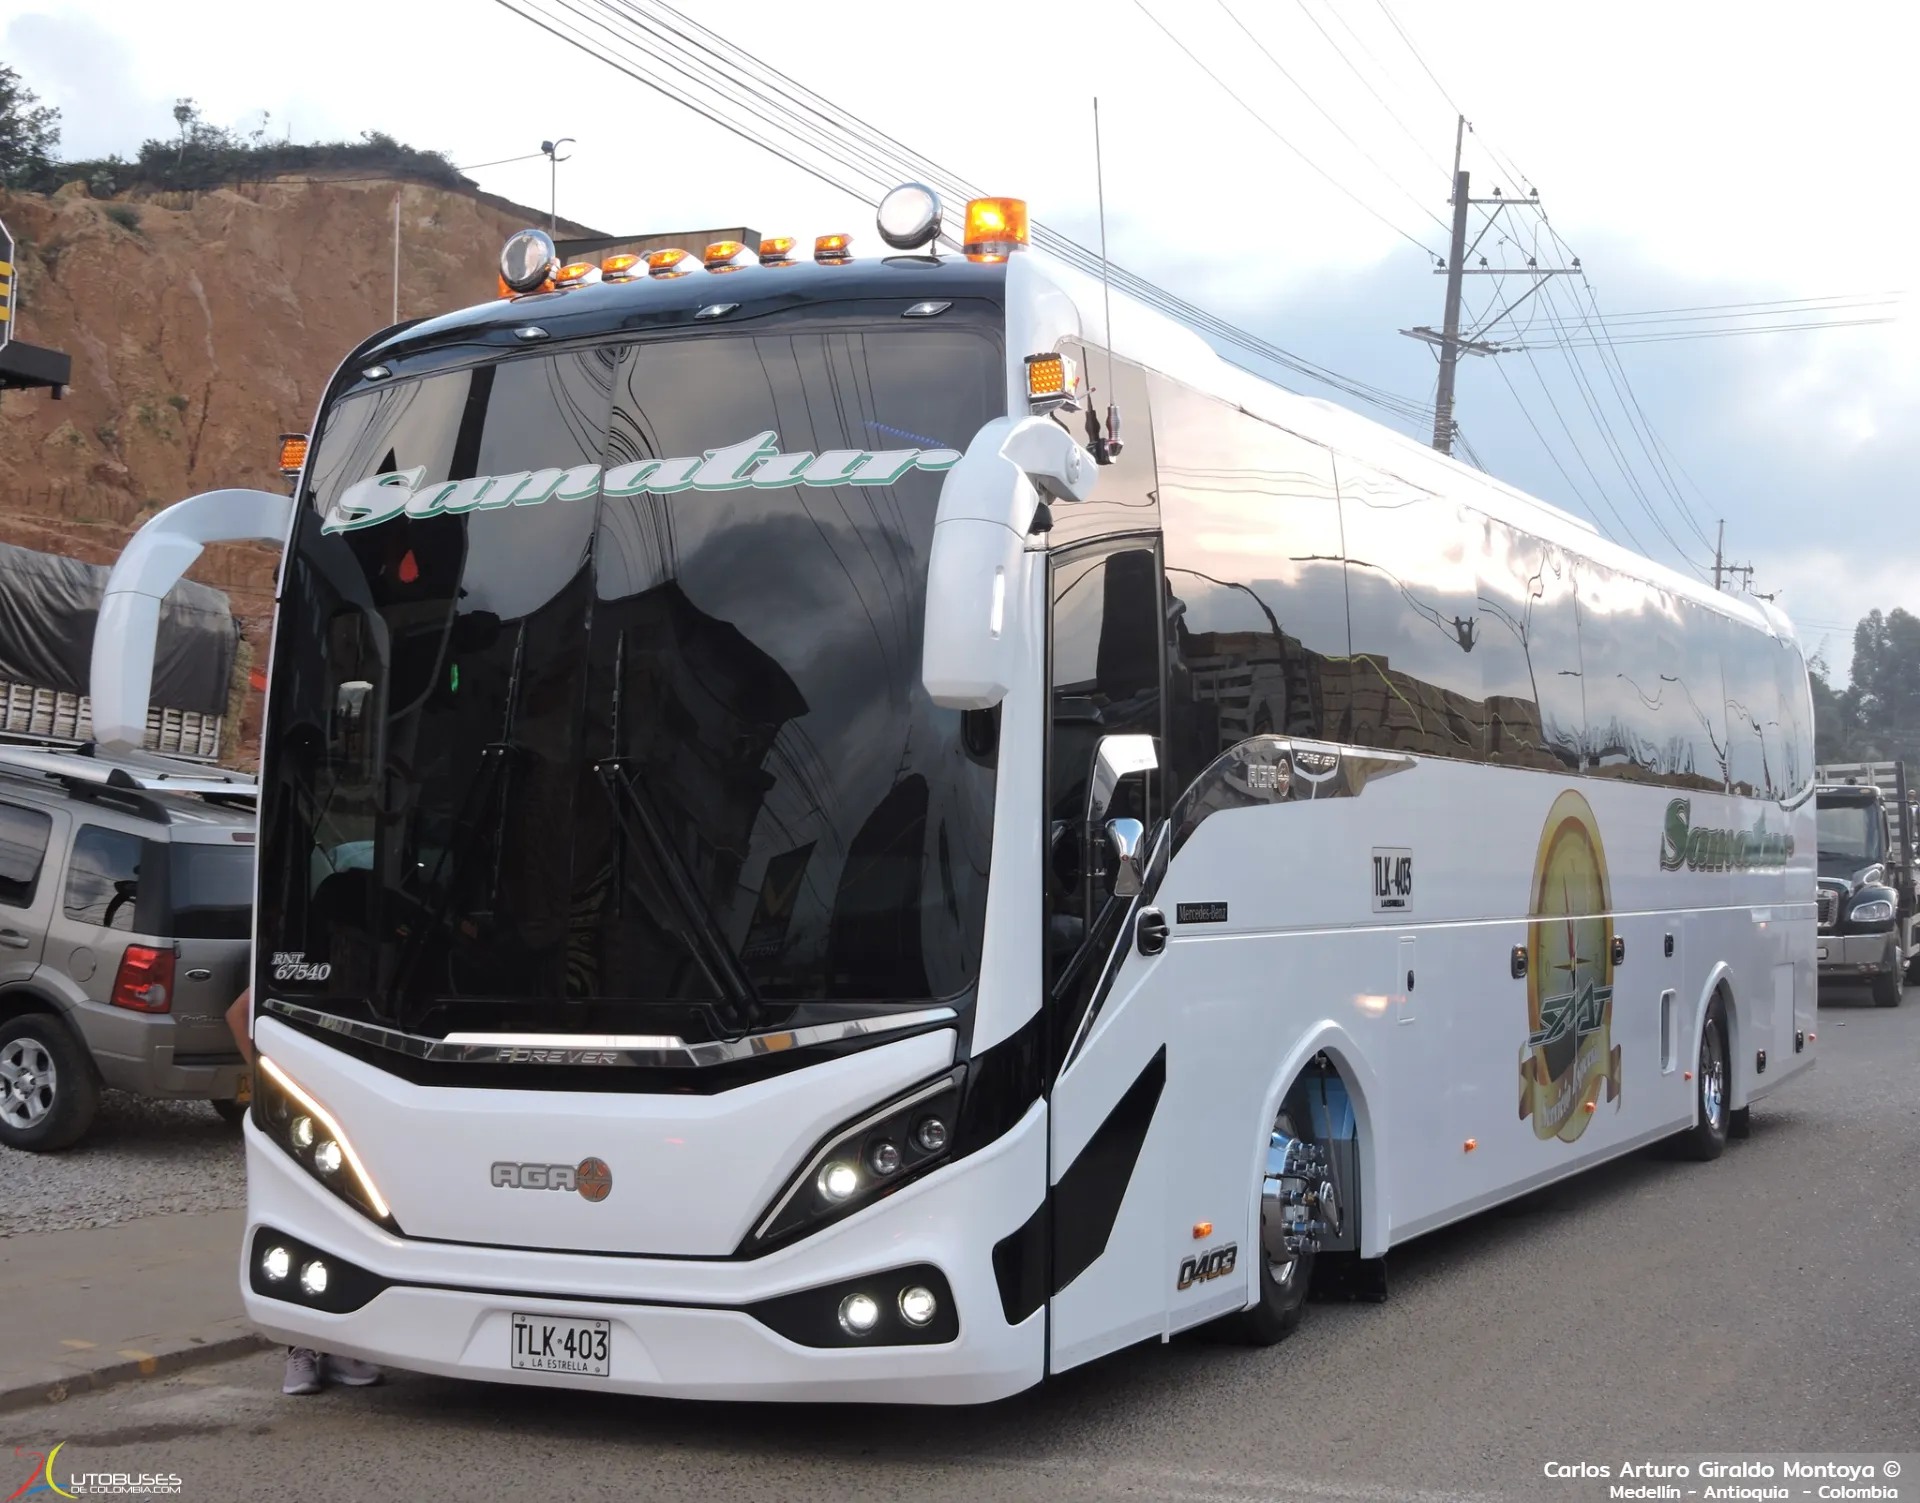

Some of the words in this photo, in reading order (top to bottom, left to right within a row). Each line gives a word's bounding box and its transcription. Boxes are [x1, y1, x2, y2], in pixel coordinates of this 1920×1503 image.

[321, 430, 964, 536] Samatur
[271, 951, 306, 965] RNT
[274, 962, 331, 980] 67540
[496, 1049, 619, 1065] FOREVER
[491, 1161, 579, 1191] AGA
[532, 1358, 543, 1368] LA
[547, 1360, 588, 1371] ESTRELLA
